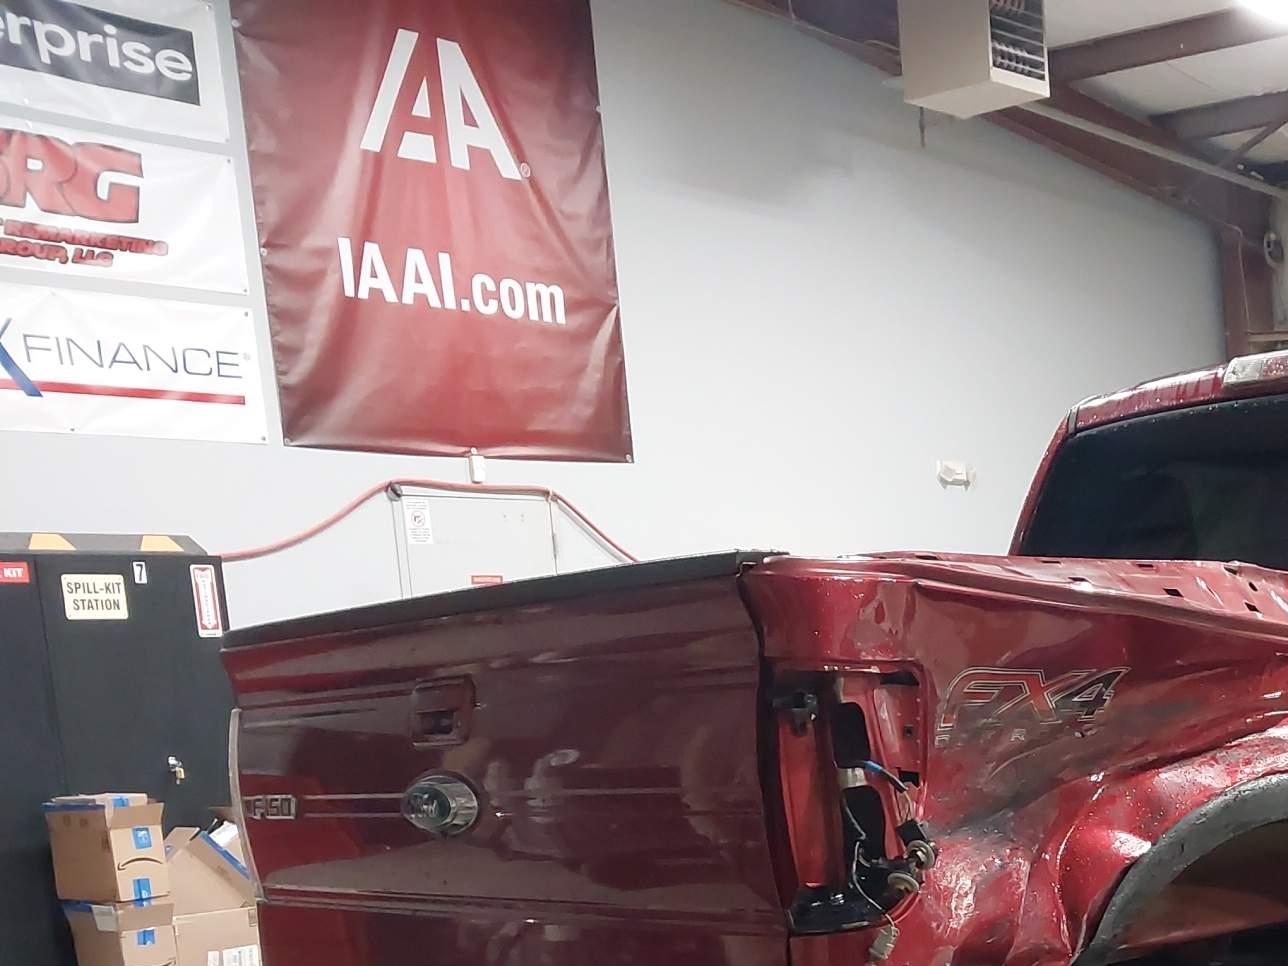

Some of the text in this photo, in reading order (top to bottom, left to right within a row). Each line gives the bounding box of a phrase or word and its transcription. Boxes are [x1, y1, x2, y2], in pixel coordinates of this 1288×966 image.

[0, 11, 193, 81] rprise
[337, 236, 567, 325] IAAI.com
[23, 333, 243, 379] FINANCE
[3, 567, 24, 578] KIT
[66, 581, 122, 595] SPILL-KIT
[136, 563, 143, 582] 7
[73, 598, 121, 611] STATION
[938, 667, 1132, 731] FX4
